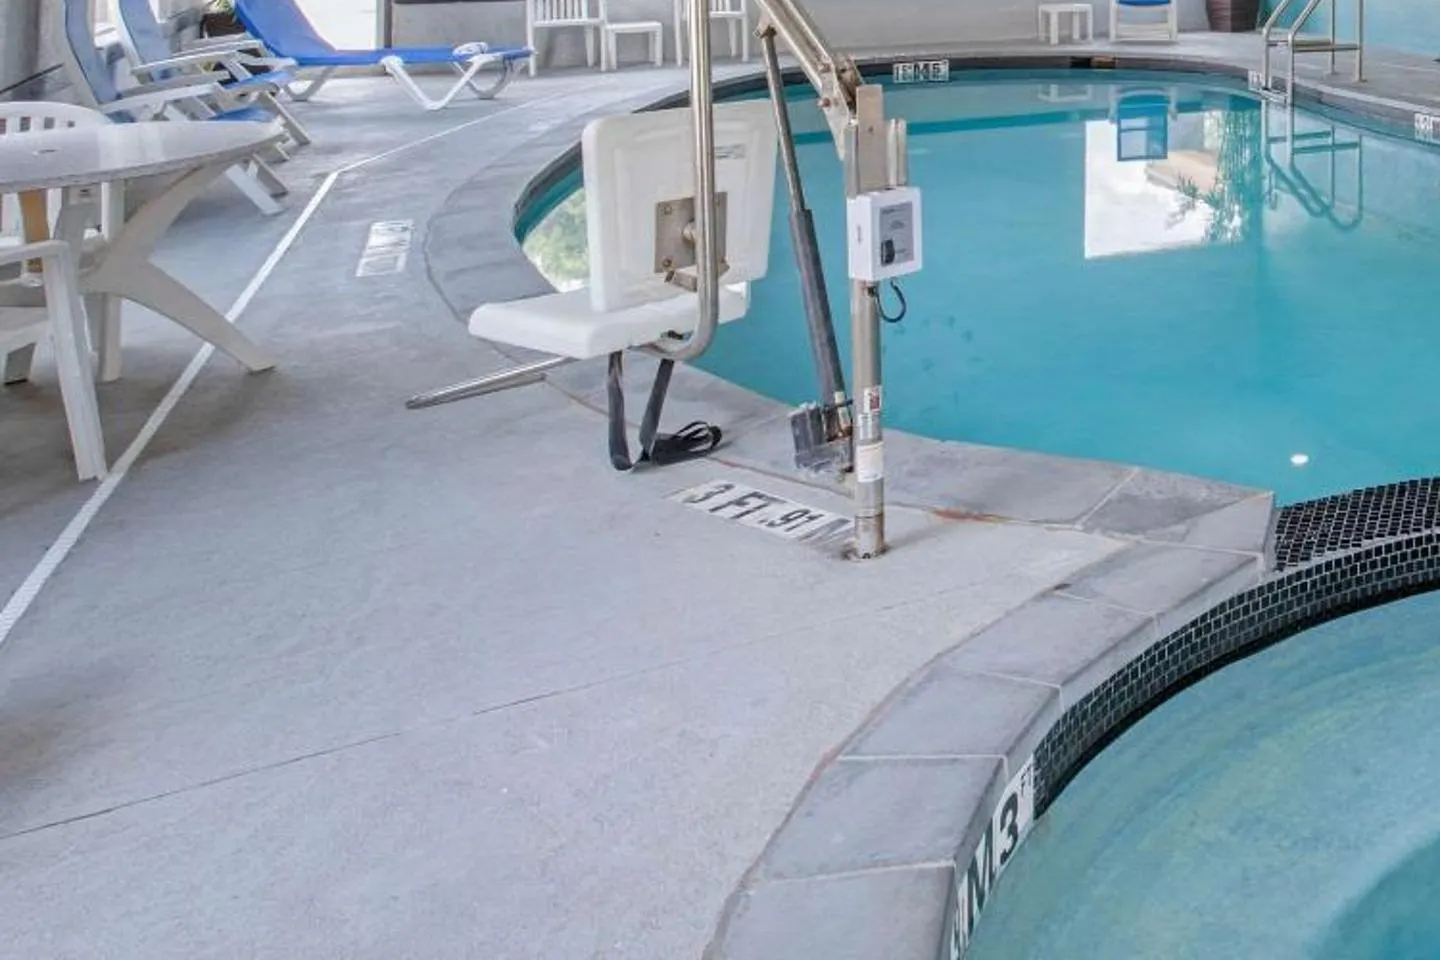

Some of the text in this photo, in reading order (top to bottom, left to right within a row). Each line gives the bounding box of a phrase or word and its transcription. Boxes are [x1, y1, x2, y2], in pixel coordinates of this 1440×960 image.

[682, 483, 735, 504] 3
[708, 490, 788, 520] FT
[999, 791, 1019, 867] 3
